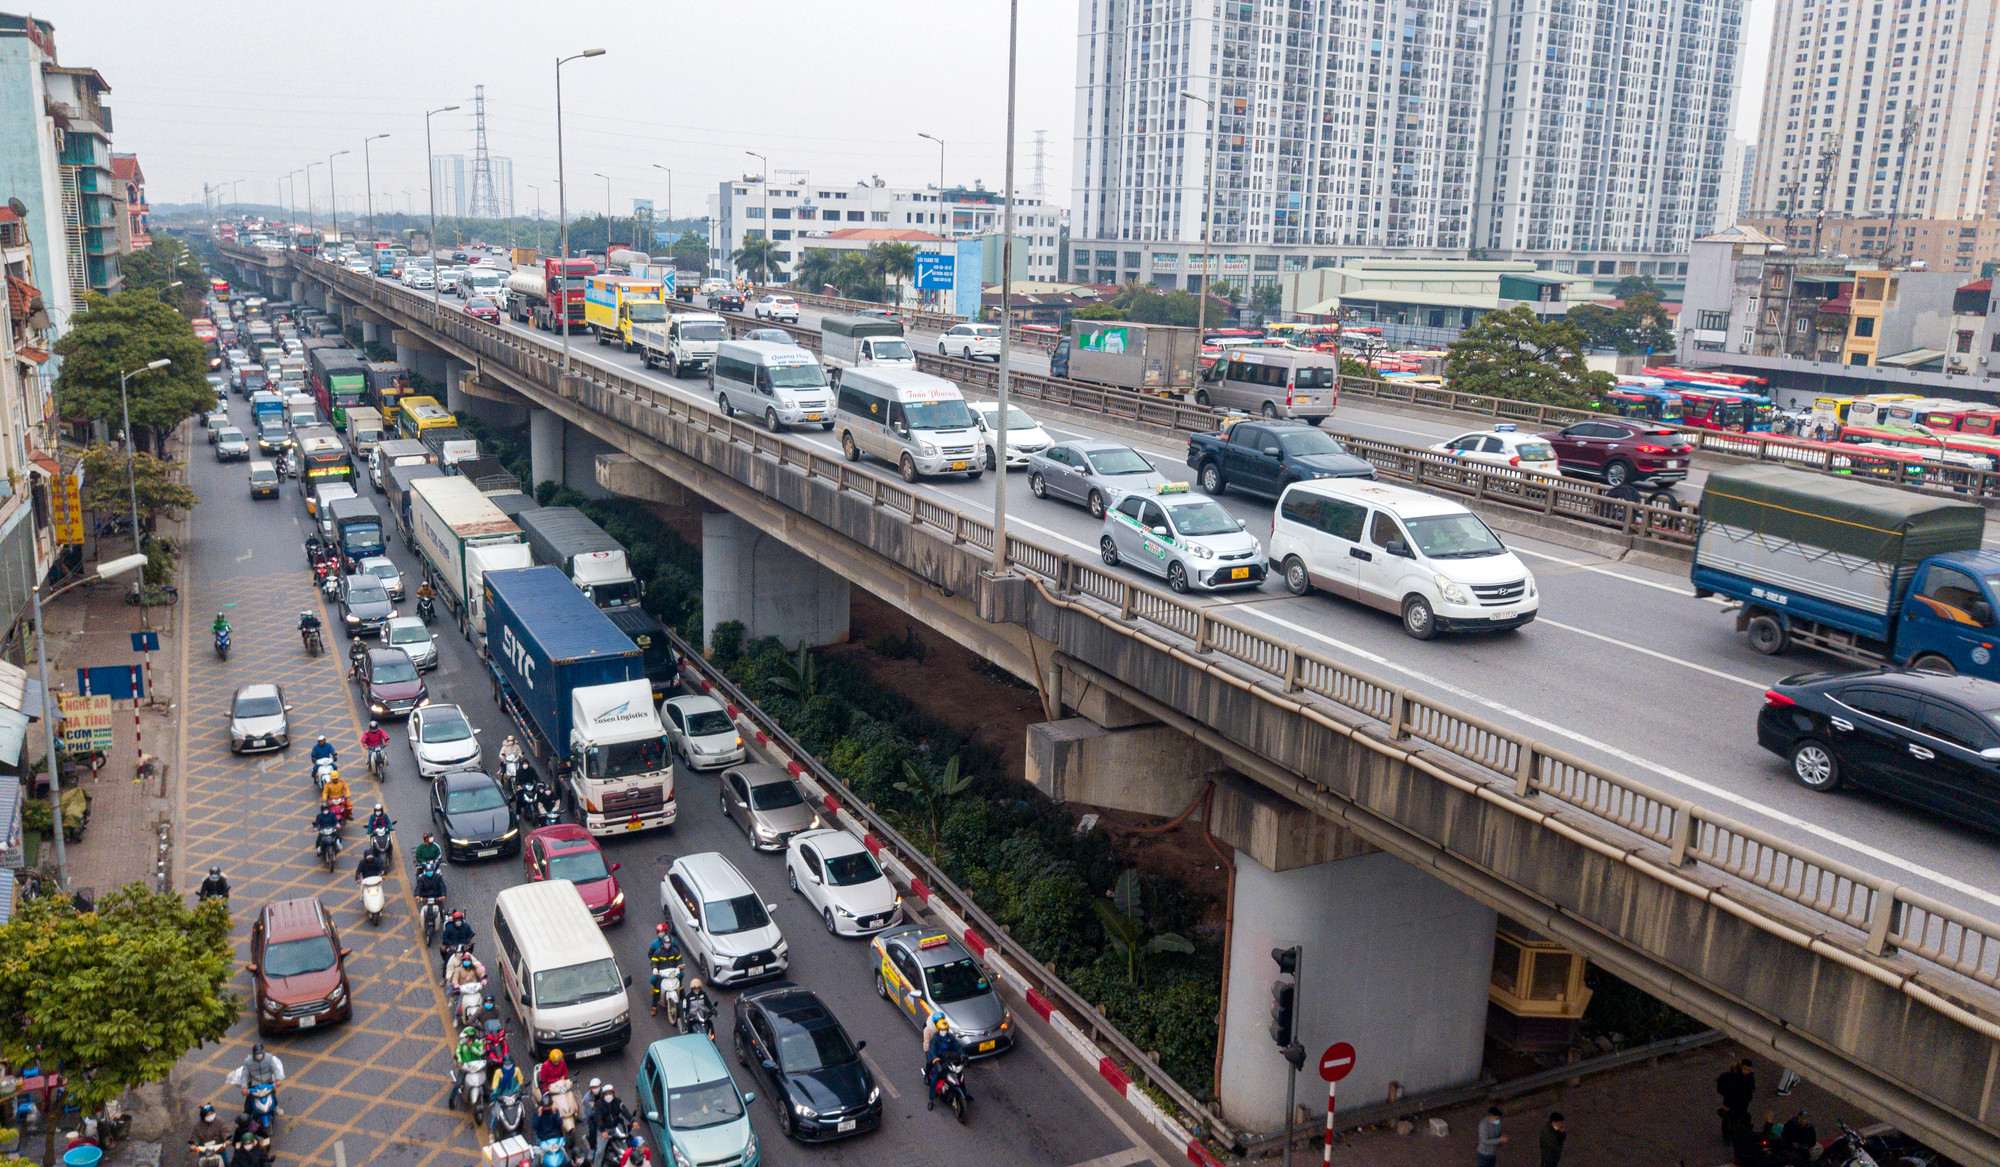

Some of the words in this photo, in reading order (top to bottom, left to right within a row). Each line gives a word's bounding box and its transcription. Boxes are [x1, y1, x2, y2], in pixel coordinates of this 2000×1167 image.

[502, 624, 535, 690] SITC
[593, 715, 616, 724] Yusen
[616, 711, 648, 721] Logistics
[66, 729, 92, 740] CƠM
